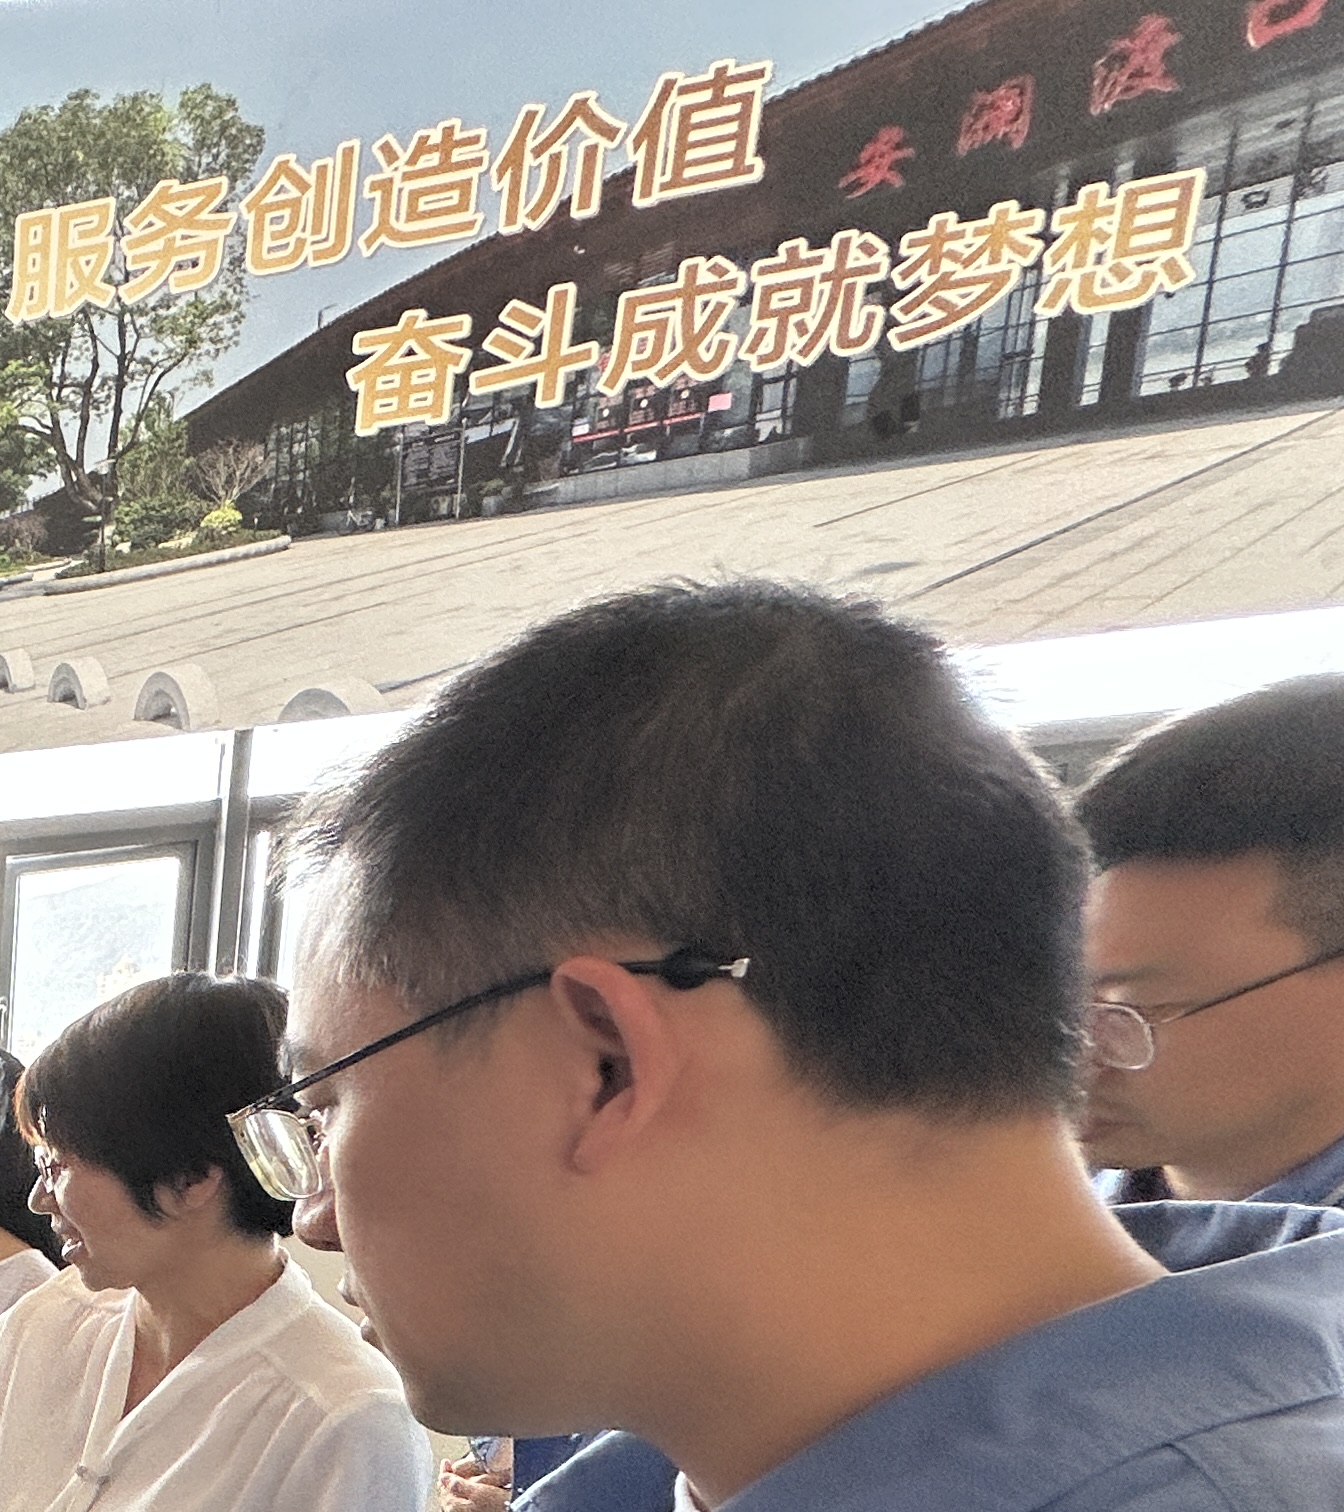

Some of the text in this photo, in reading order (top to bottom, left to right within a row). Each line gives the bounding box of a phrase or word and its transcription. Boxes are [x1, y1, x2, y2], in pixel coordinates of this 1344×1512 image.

[6, 58, 772, 325] 服务创造价值
[346, 167, 1207, 437] 奋斗成就梦想
